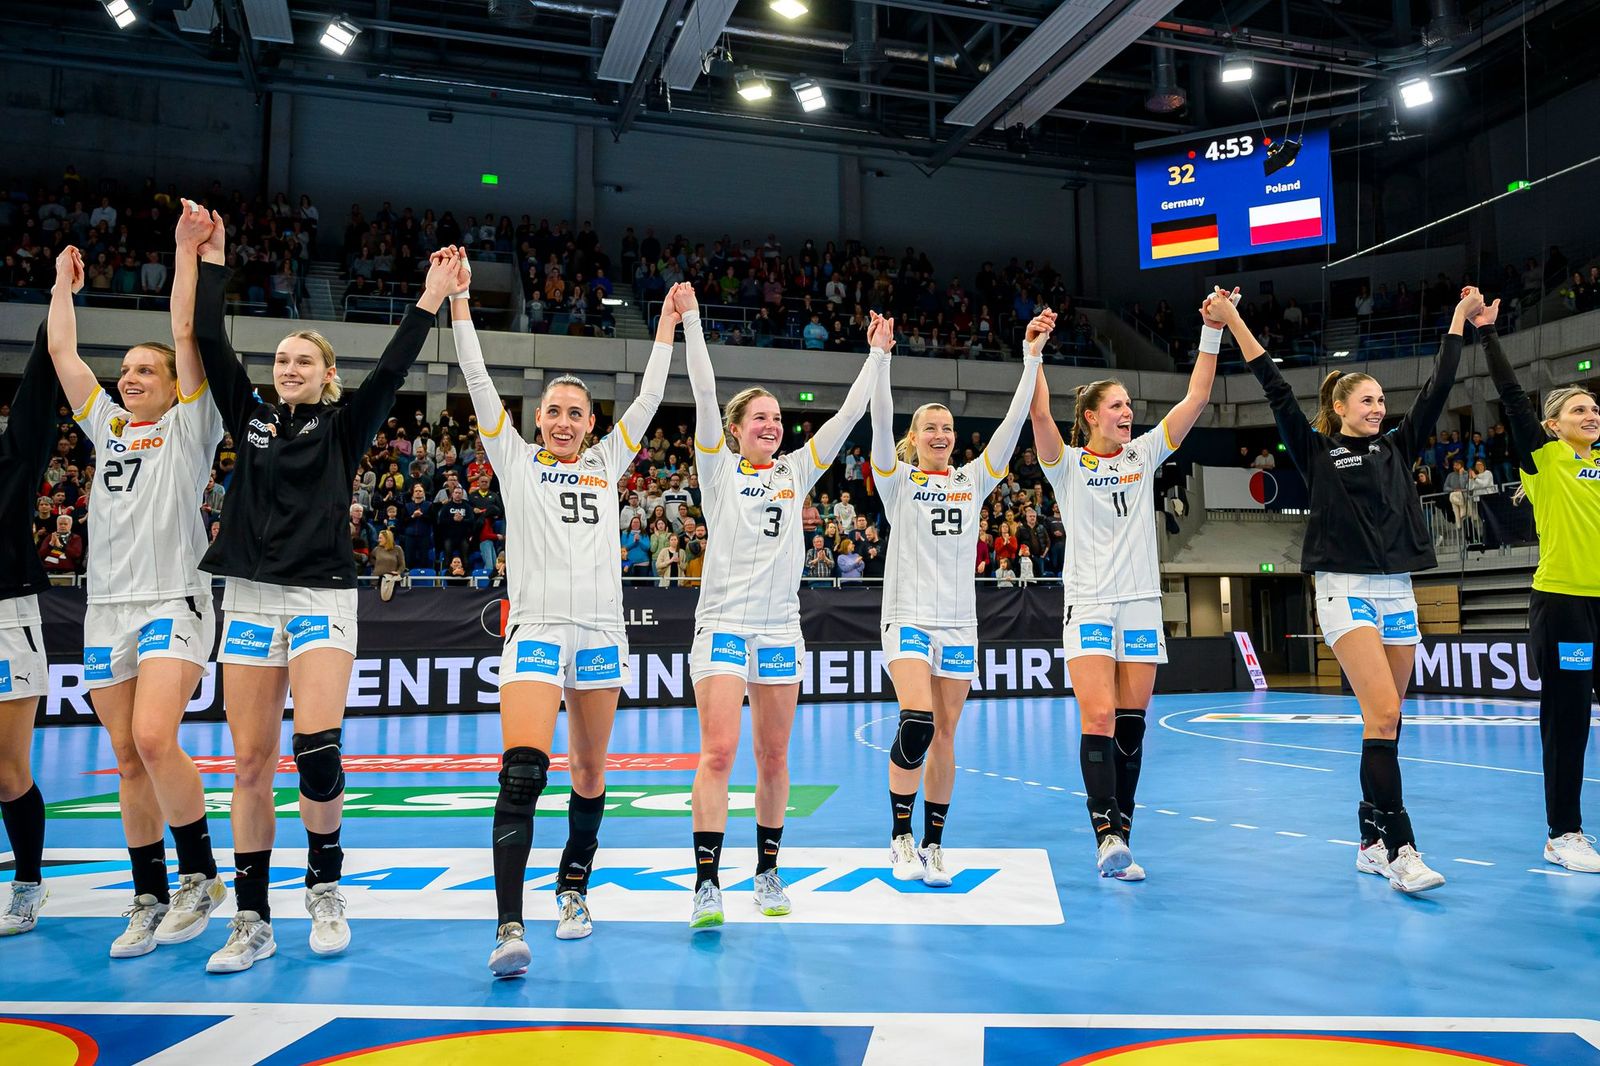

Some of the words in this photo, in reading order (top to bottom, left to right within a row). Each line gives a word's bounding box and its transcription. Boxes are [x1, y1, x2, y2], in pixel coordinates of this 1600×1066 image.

[1205, 136, 1254, 161] 4:53
[1168, 164, 1195, 185] 32
[1265, 180, 1301, 194] Poland
[1161, 197, 1205, 210] Germany
[103, 457, 142, 492] 27
[541, 472, 608, 488] AUTOHERO
[1087, 472, 1142, 487] AUTOHER
[559, 492, 600, 525] 95
[1112, 491, 1127, 517] 11
[763, 506, 782, 537] 3
[930, 508, 962, 536] 29
[1415, 643, 1542, 692] MITSU
